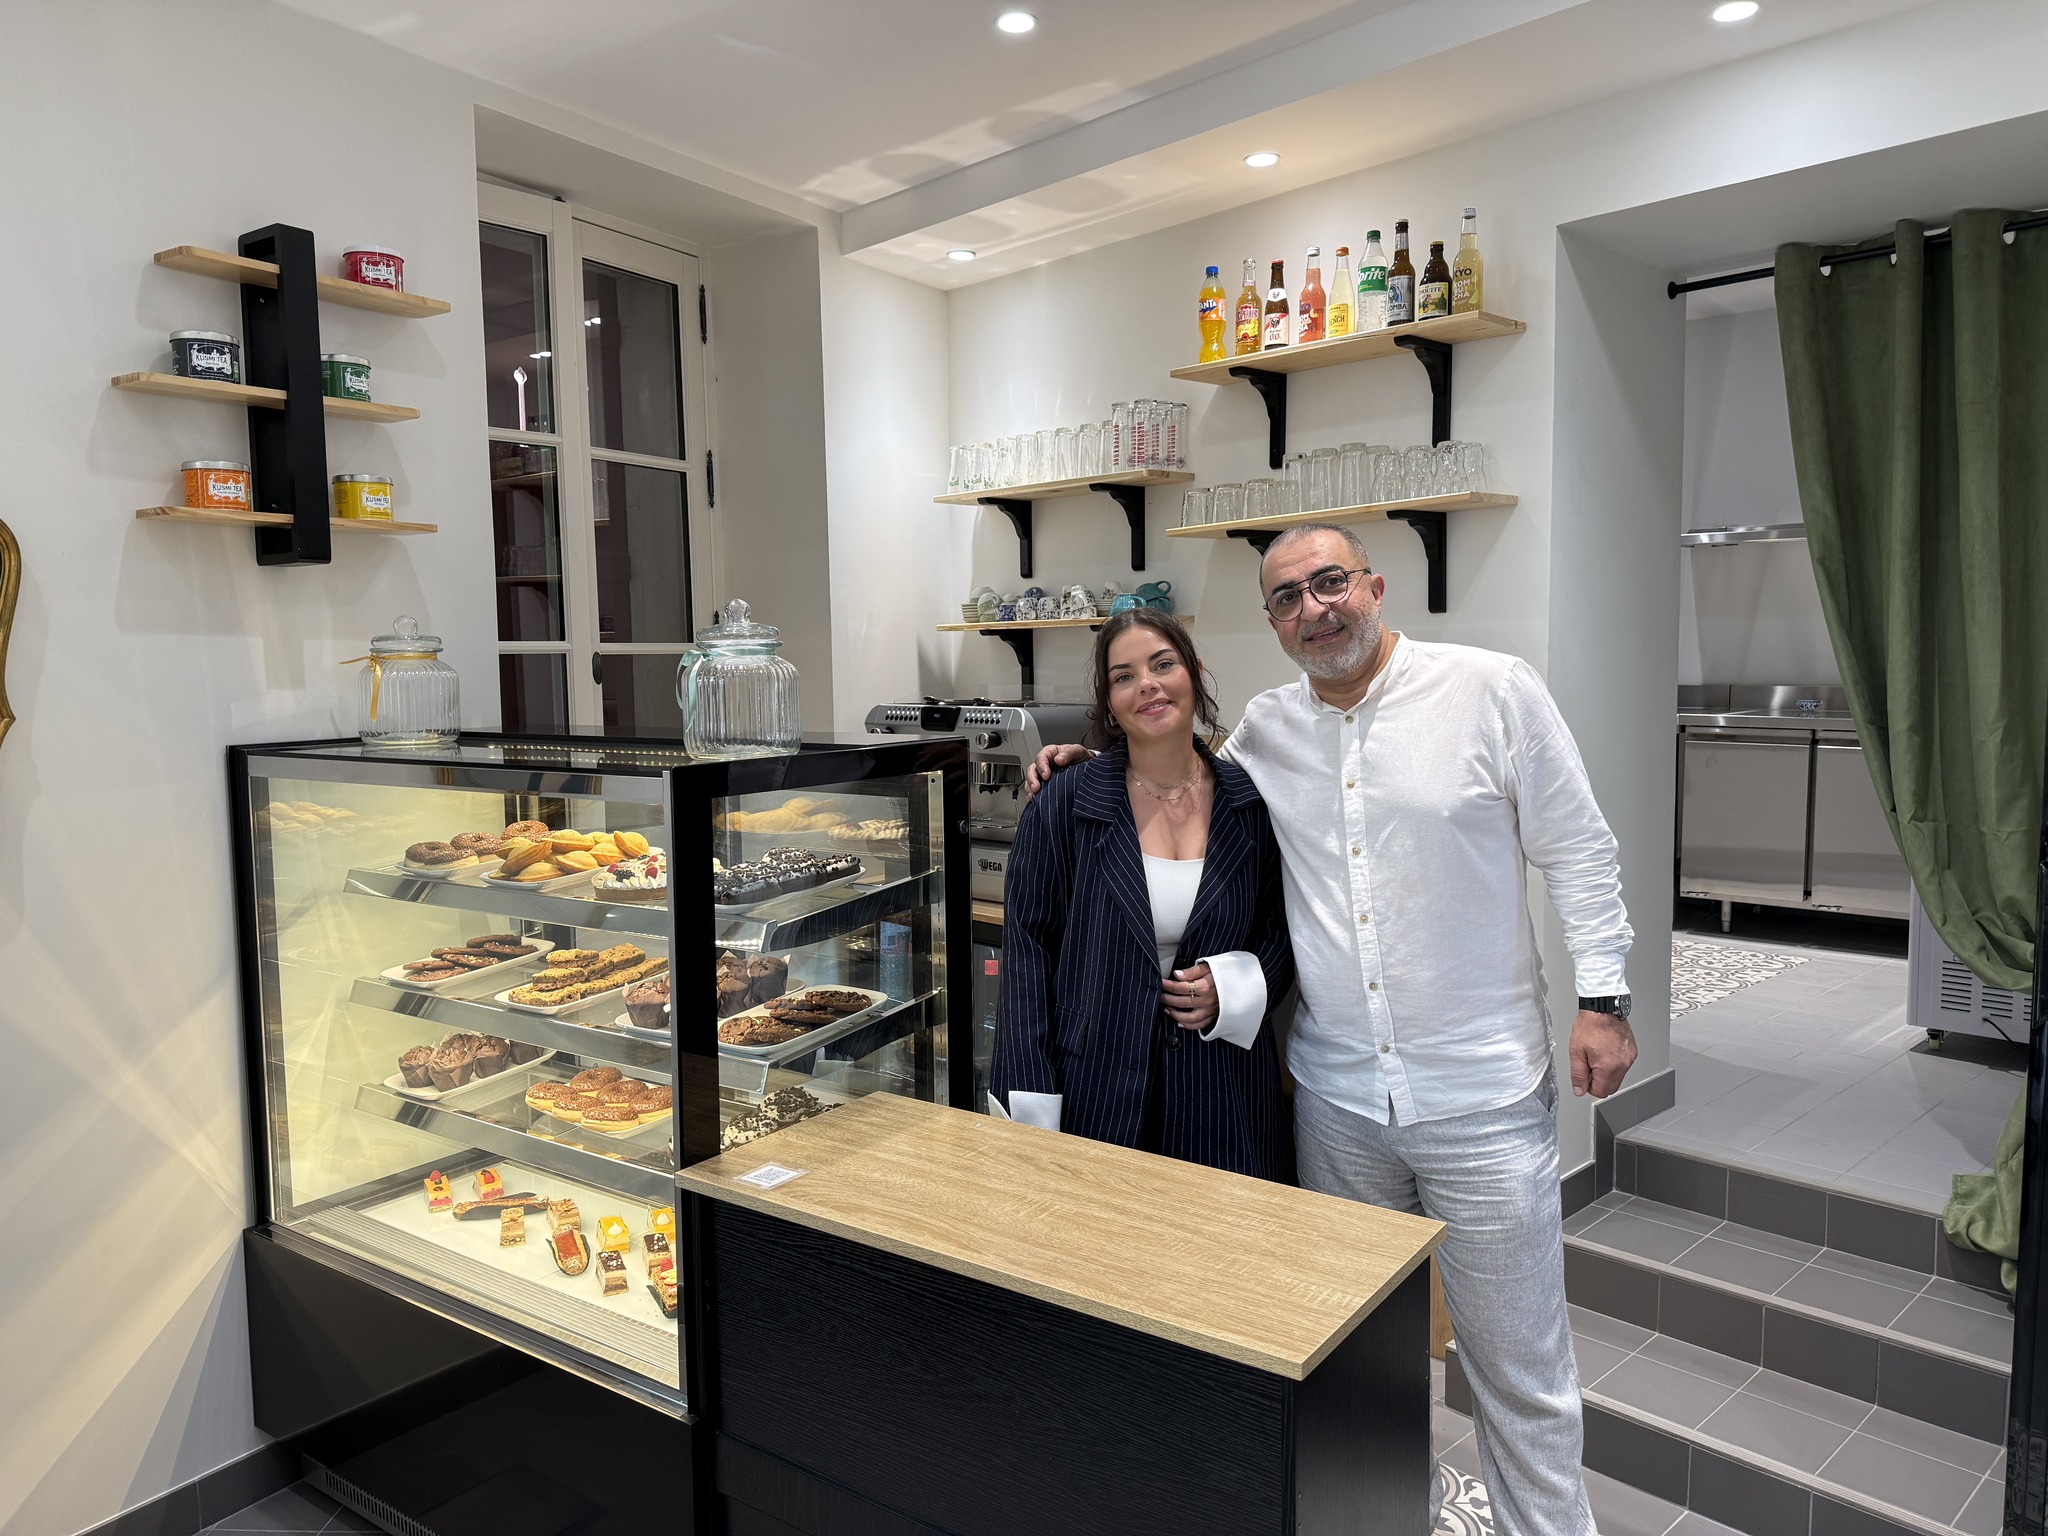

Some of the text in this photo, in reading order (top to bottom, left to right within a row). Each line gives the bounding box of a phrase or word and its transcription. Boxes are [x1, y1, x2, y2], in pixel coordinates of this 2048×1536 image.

[195, 354, 216, 362] KUSMI
[217, 356, 228, 364] TEA
[233, 485, 243, 493] TEA
[980, 859, 1002, 872] WEGA
